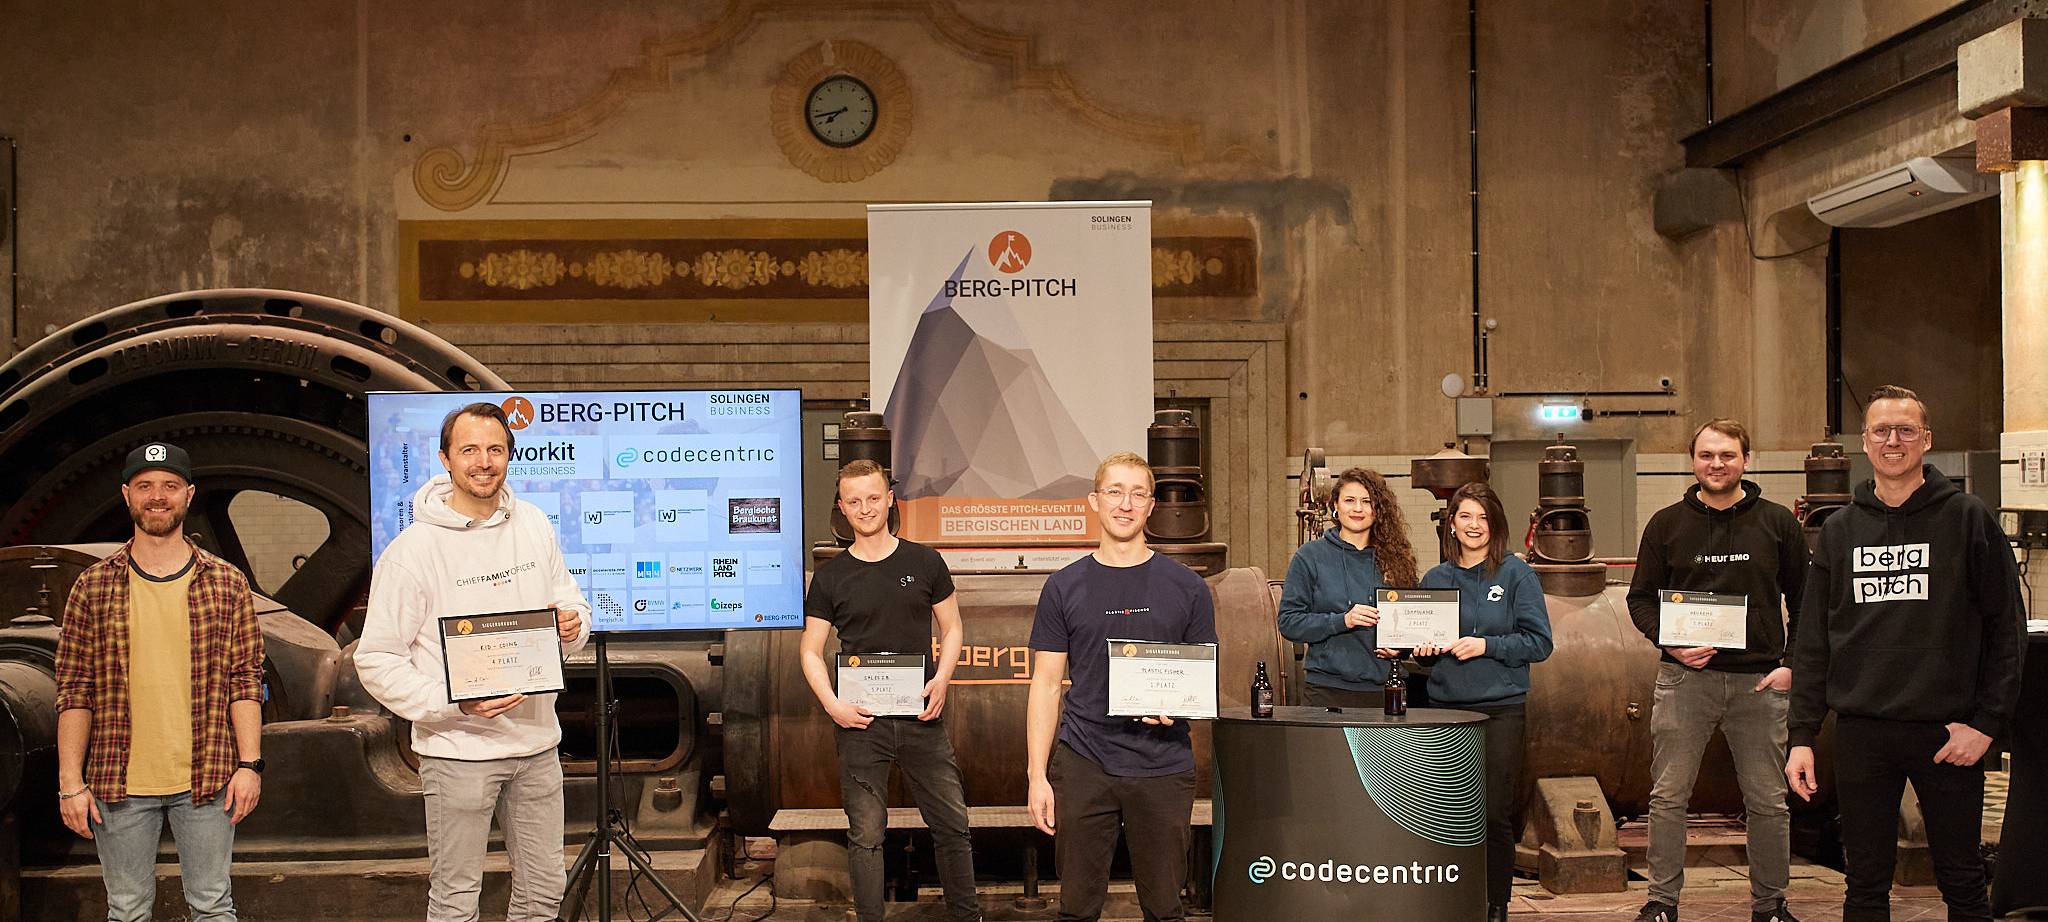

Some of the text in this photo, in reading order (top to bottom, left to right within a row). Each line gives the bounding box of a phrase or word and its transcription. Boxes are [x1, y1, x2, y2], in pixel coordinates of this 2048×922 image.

[1091, 215, 1132, 223] SOLINGEN
[1091, 223, 1132, 231] BUSINESS
[944, 278, 1077, 298] BERG-PITCH
[710, 394, 770, 404] SOLINGEN
[539, 402, 685, 423] BERG-PITCH
[710, 406, 771, 416] BUSINESS
[643, 446, 775, 463] codecentric
[530, 466, 576, 475] BUSINESS
[733, 505, 777, 515] Bergische
[941, 503, 1086, 514] DAS GRÖSSTE PITCH-EVENT IM
[732, 514, 777, 523] Braukunst
[945, 518, 1083, 532] BERGISCHEN LAND
[1860, 546, 1922, 568] berg
[1860, 573, 1922, 603] pitch
[1281, 859, 1460, 885] codecentric
